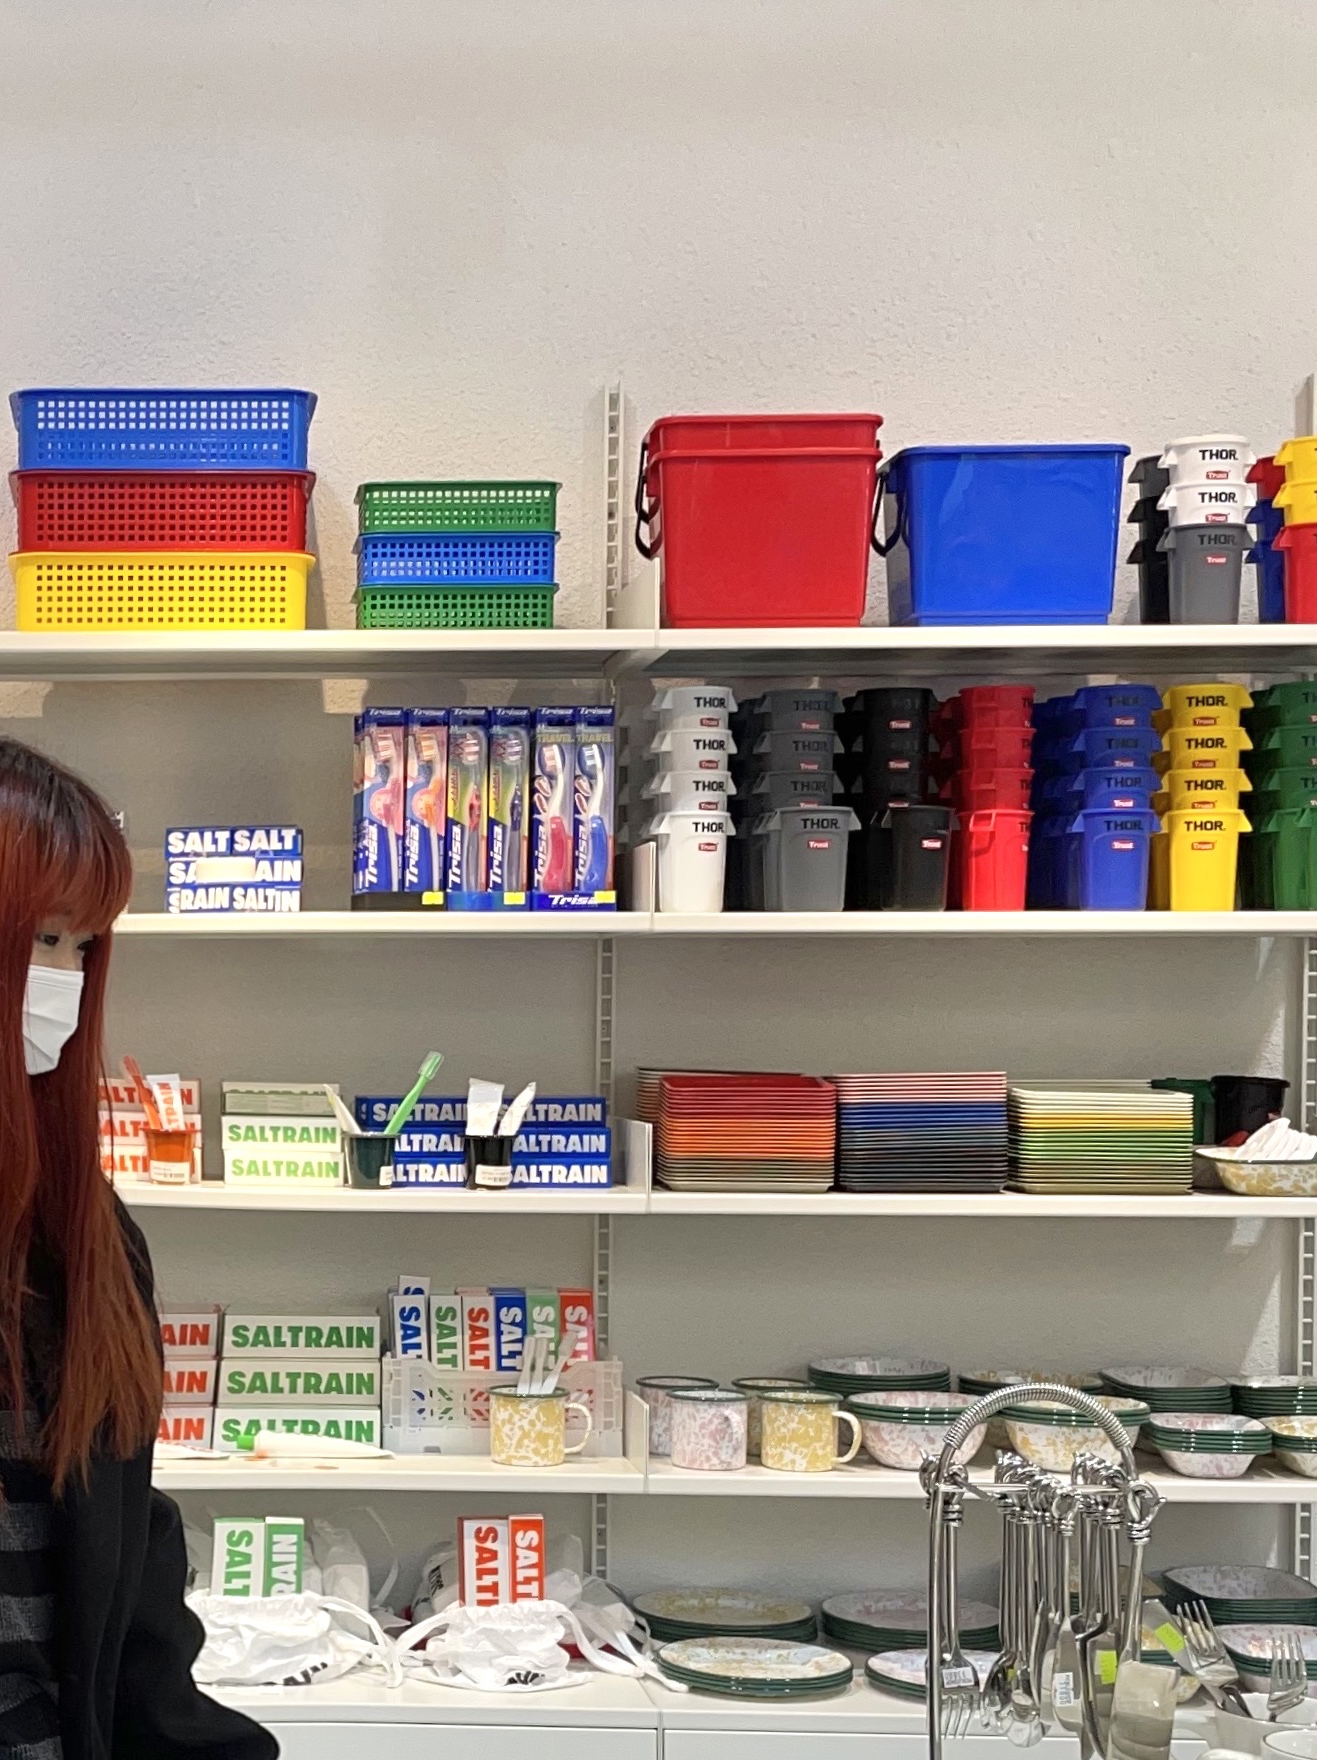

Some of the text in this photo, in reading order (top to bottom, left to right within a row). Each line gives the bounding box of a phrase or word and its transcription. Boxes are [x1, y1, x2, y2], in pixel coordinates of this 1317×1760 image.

[168, 829, 296, 854] SALT SALT
[448, 824, 461, 884] Trisa
[490, 825, 503, 884] Trisa
[169, 860, 302, 884] SAAIN
[372, 1103, 602, 1122] SATRAI LTRAIN
[228, 1124, 337, 1144] SALTRAIN
[512, 1134, 606, 1152] ALTRAIN
[232, 1158, 340, 1178] SALTRAIN
[512, 1164, 608, 1184] ALTRAIN
[232, 1324, 374, 1348] SALTRAIN
[435, 1306, 458, 1368] SALT
[468, 1307, 490, 1370] SALT
[499, 1306, 524, 1370] SALT
[227, 1371, 374, 1395] SALTRAIN
[515, 1530, 540, 1600] SALT
